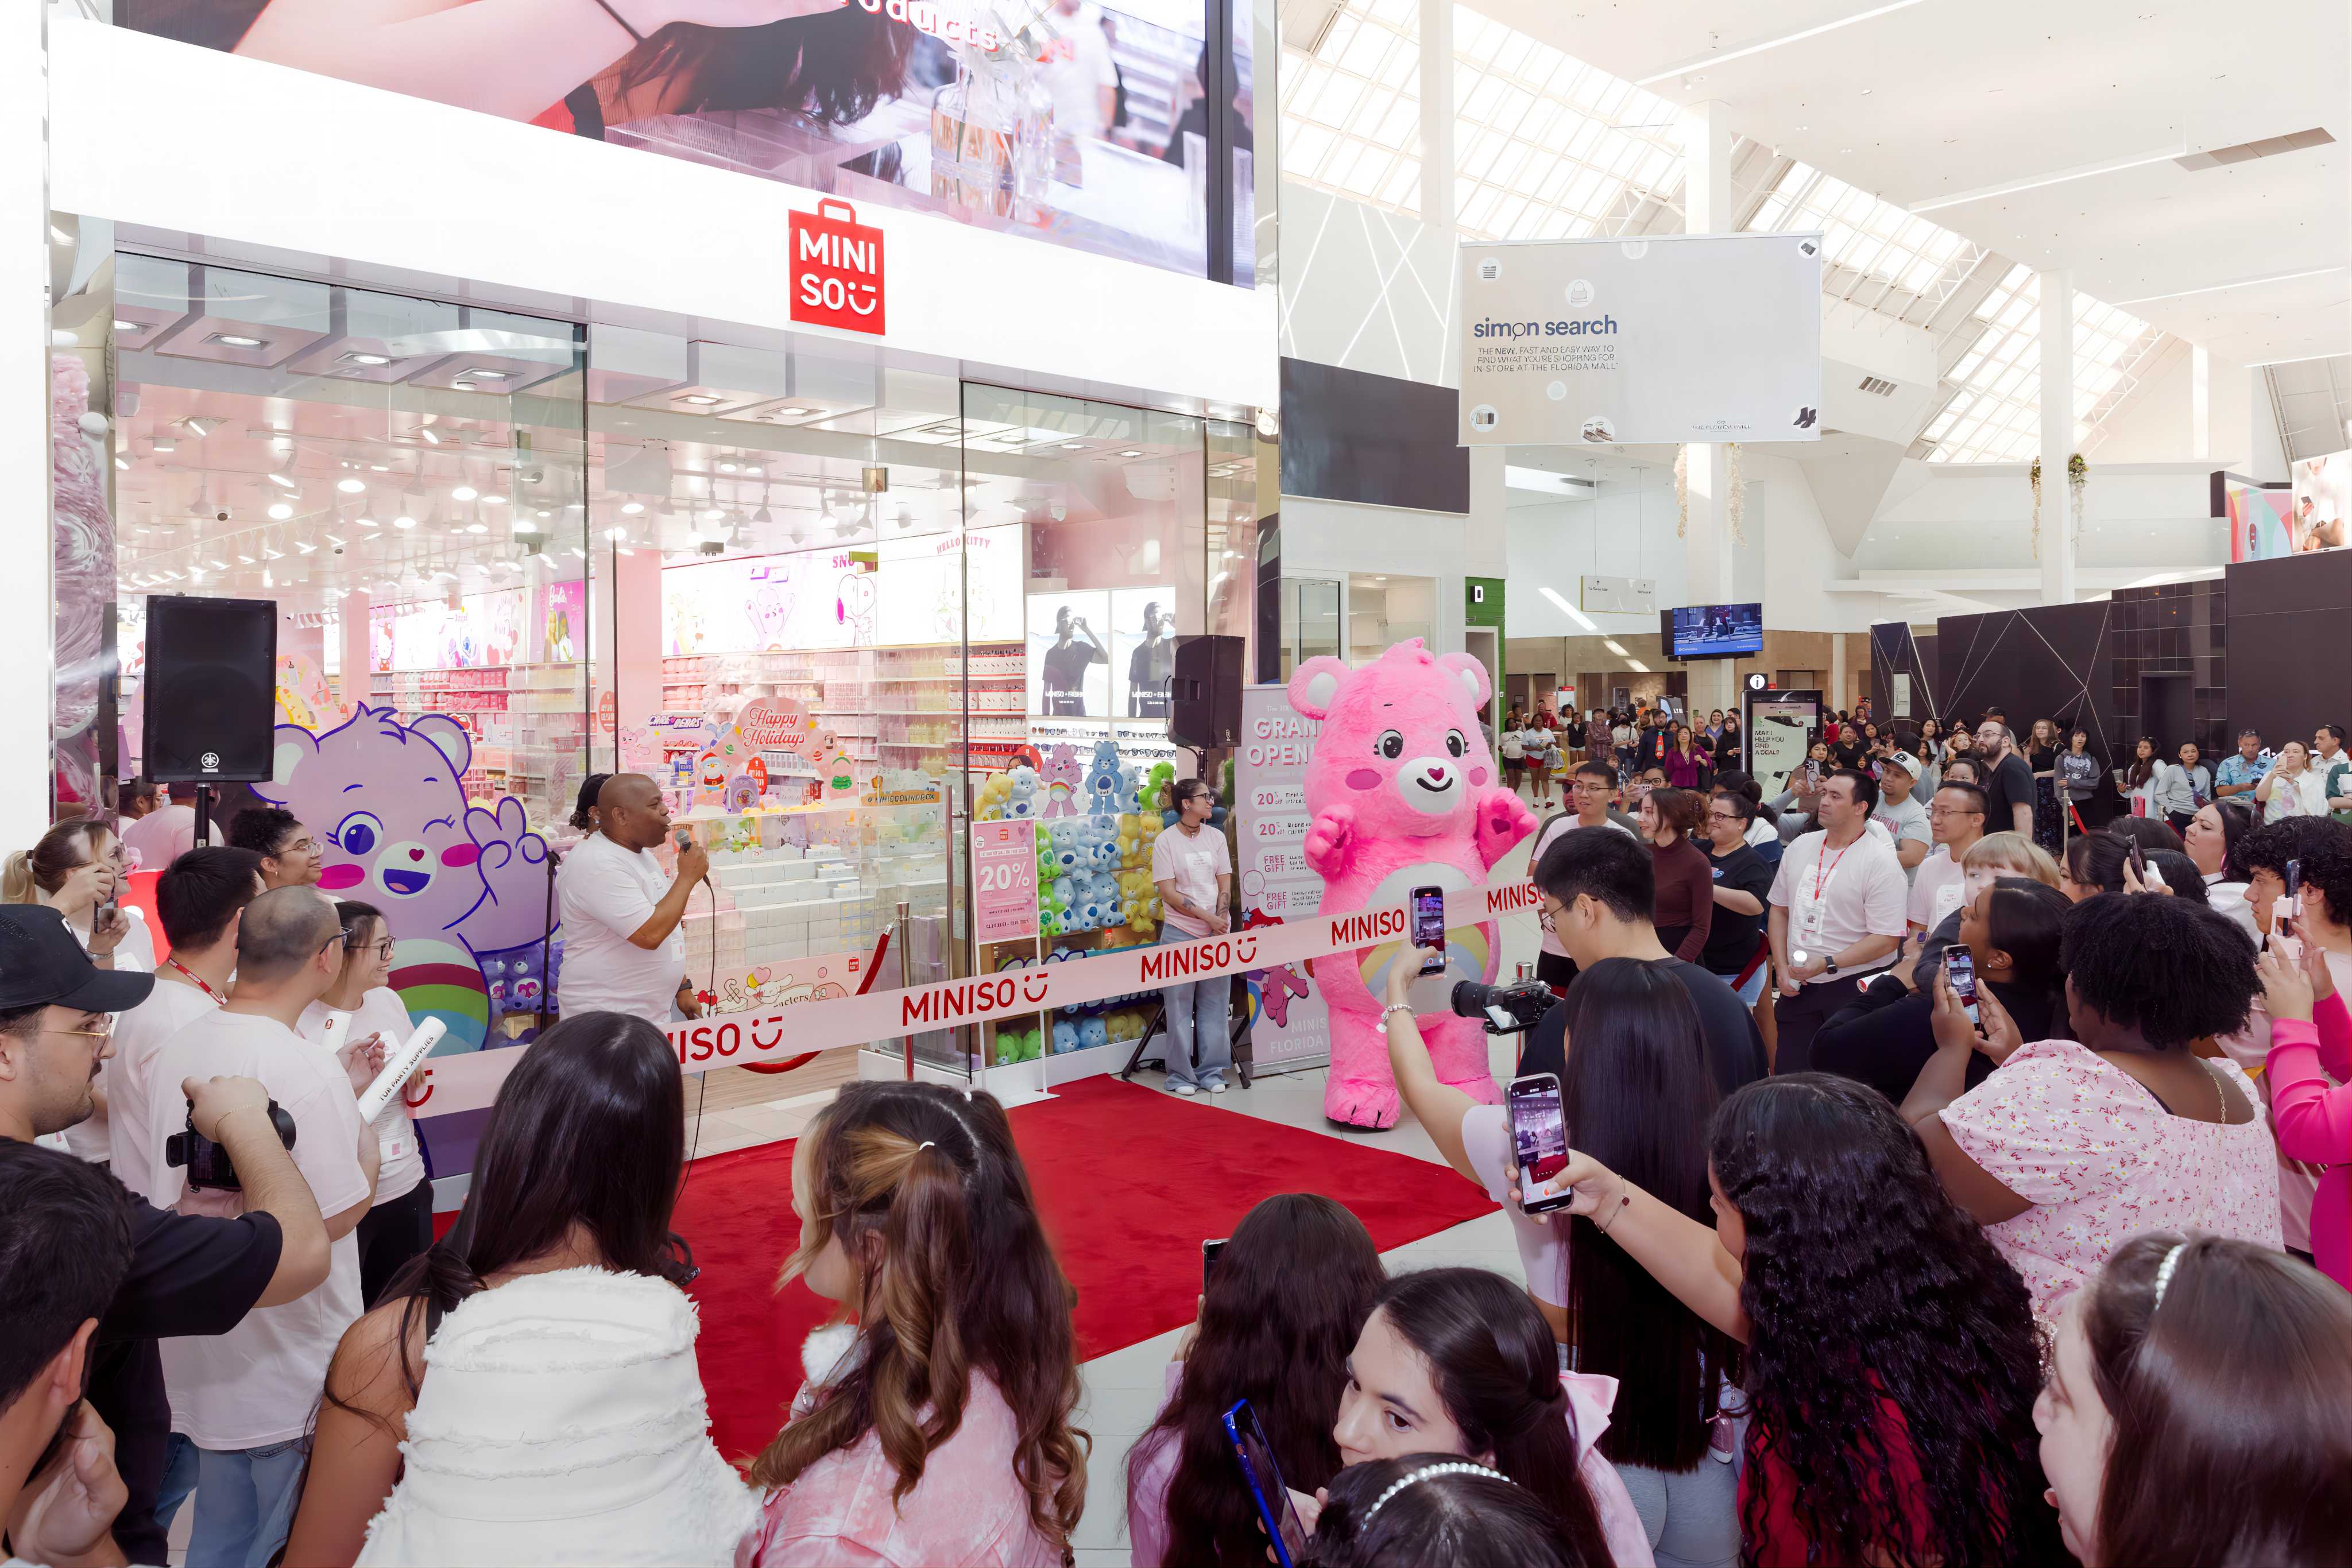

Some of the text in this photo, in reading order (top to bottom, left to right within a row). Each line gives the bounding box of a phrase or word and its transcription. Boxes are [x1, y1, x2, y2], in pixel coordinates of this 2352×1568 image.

[799, 228, 876, 274] MINI
[1473, 314, 1617, 341] simon search
[1478, 347, 1493, 355] THE
[1560, 345, 1580, 353] EASY
[1602, 344, 1614, 353] TO
[749, 707, 798, 729] Happy
[1254, 717, 1324, 740] GRAN
[742, 727, 804, 748] Holidays
[1264, 855, 1285, 864] FREE
[1264, 864, 1285, 873] GIFT
[980, 861, 1030, 892] 20%
[1267, 892, 1287, 901] FREE
[1267, 900, 1287, 910] GIFT
[1332, 908, 1405, 946] MINISO
[1140, 942, 1231, 984] MINISO
[902, 978, 1015, 1027] MINISO
[1291, 1017, 1327, 1033] MINIS
[667, 1023, 740, 1065] ISO
[1270, 1035, 1324, 1054] FLORIDA
[391, 1065, 409, 1088] PARTY
[408, 1036, 434, 1066] SUPPLIES
